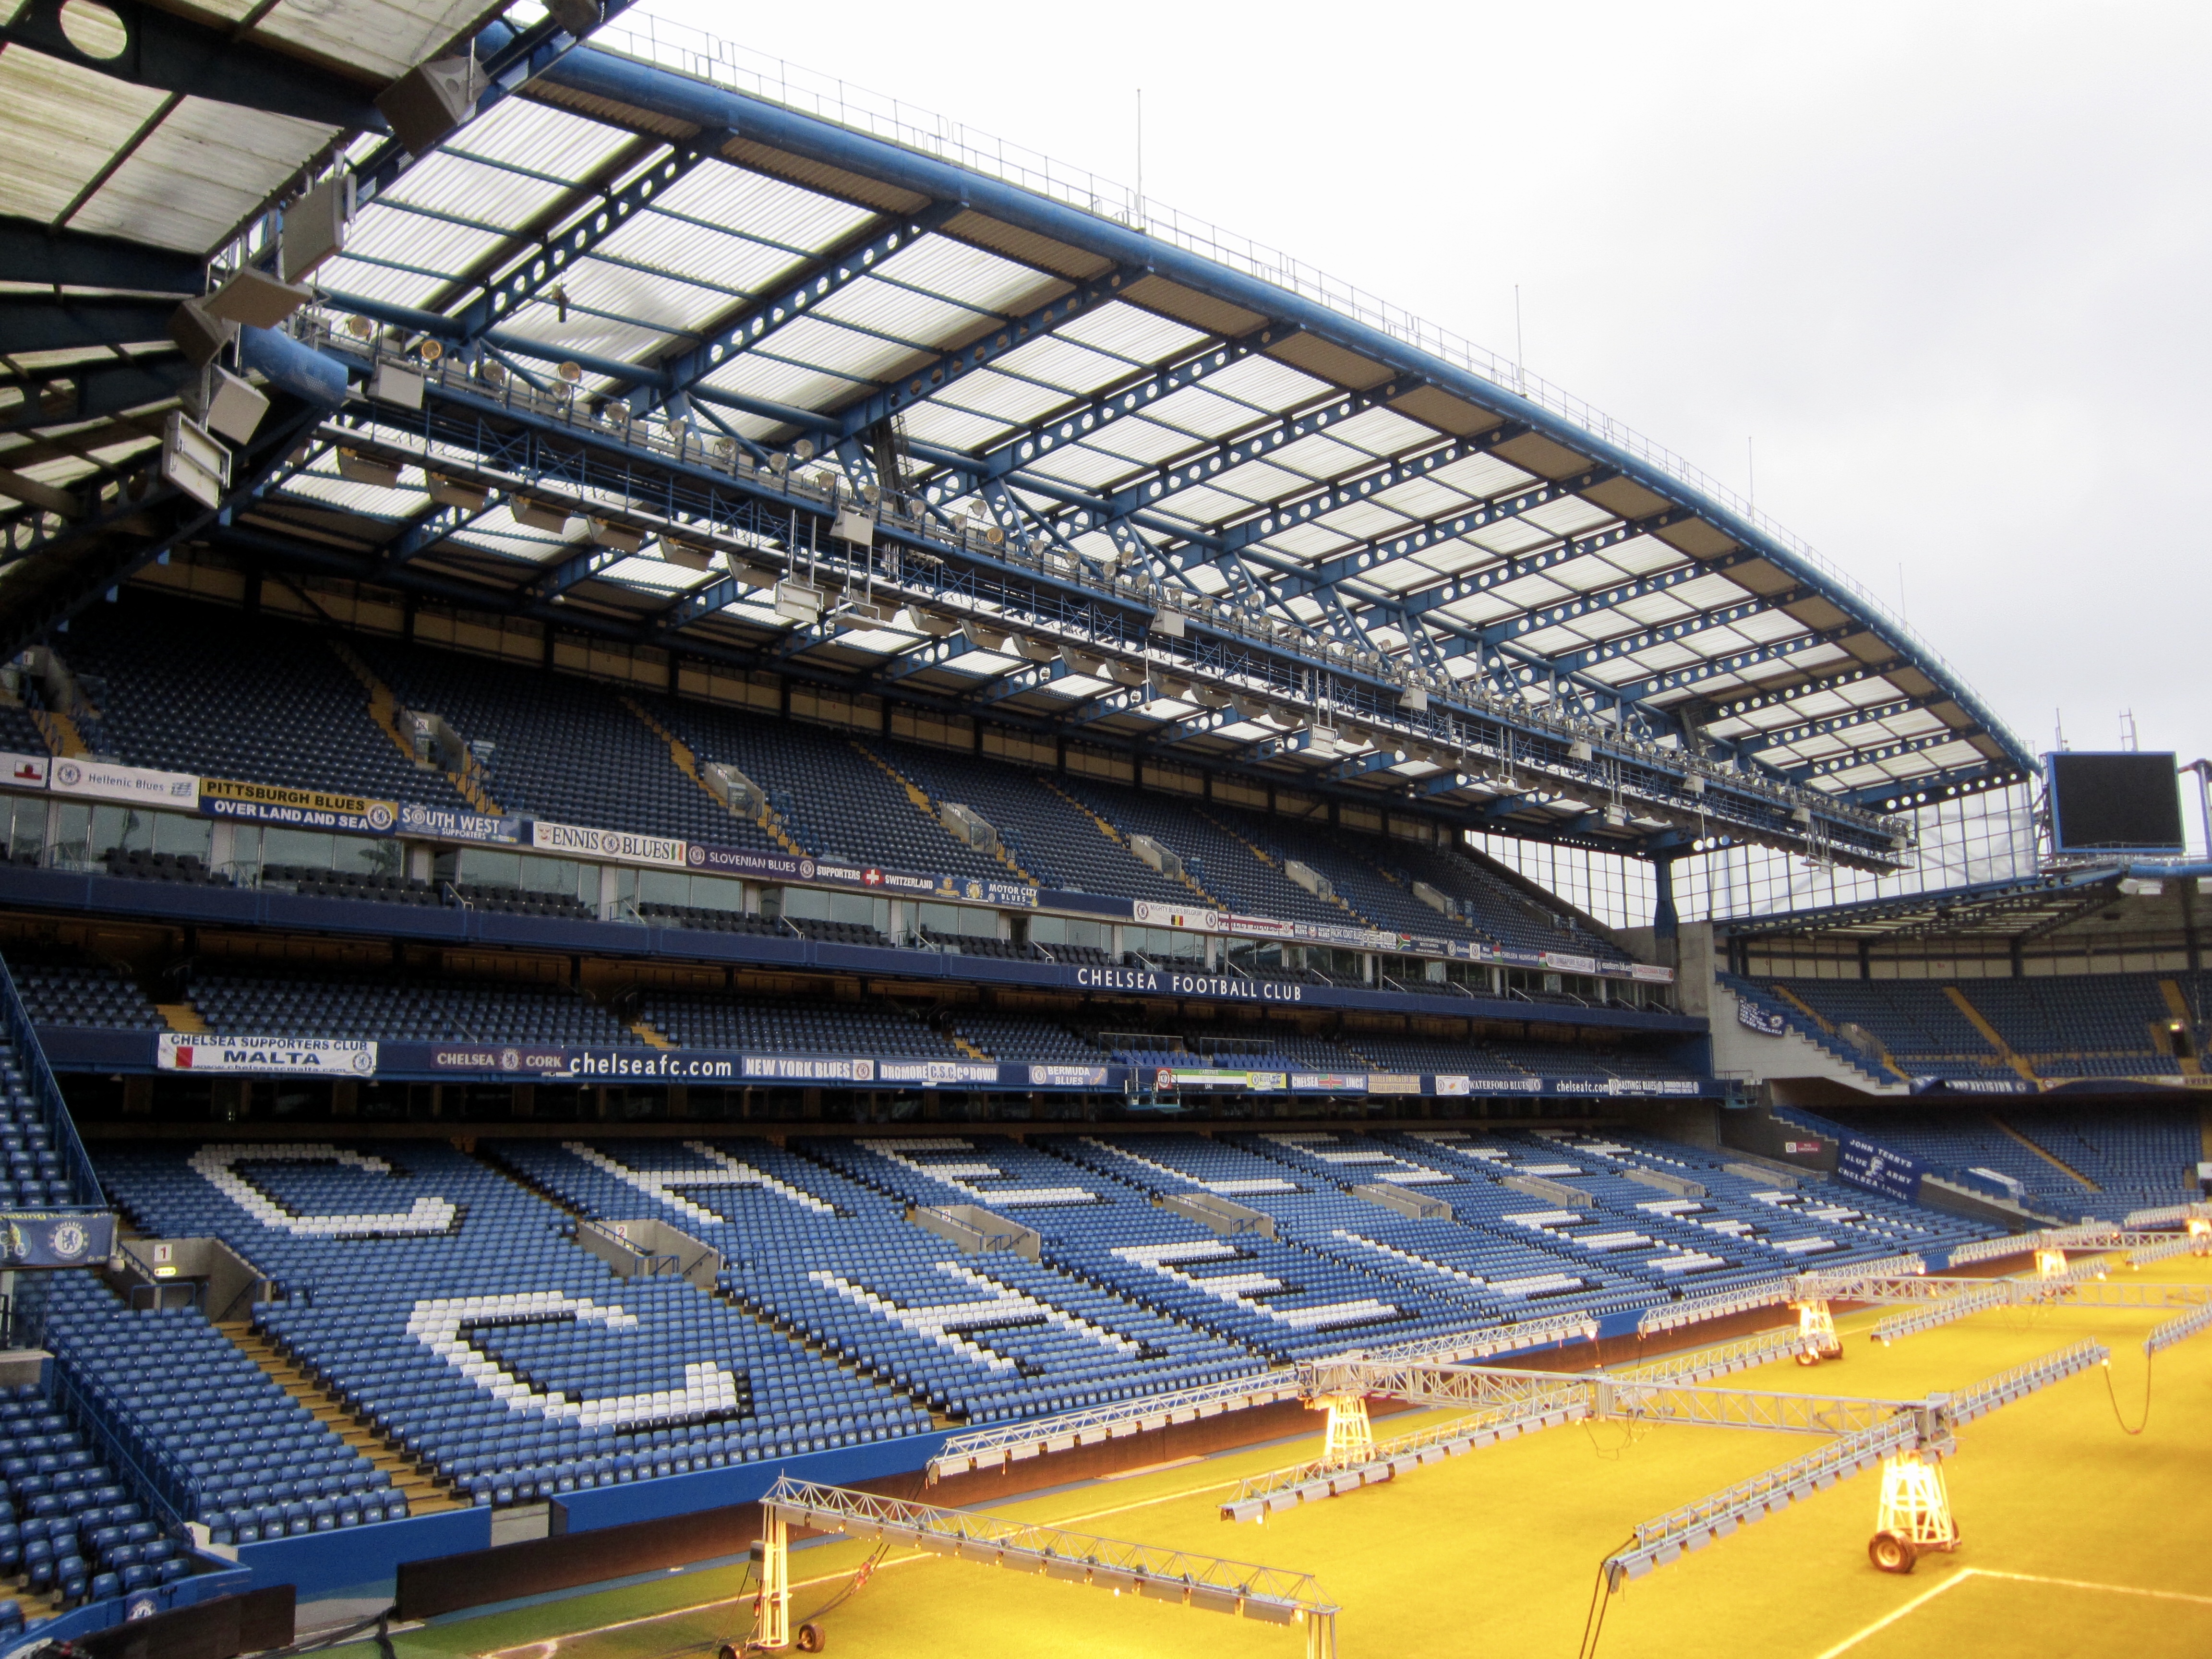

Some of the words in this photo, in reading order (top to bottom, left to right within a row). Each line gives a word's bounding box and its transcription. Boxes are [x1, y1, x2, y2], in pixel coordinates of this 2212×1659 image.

[88, 772, 132, 789] Hellenic
[136, 780, 164, 792] Blues
[207, 781, 310, 804] PITTSBURGH
[315, 795, 365, 811] BLUES
[215, 800, 256, 816] OVER
[260, 806, 302, 822] LAND
[303, 812, 336, 825] AND
[339, 816, 369, 830] SEA
[460, 815, 500, 834] WEST
[441, 827, 486, 840] SUPPORTERS
[552, 827, 599, 850] ENNIS
[622, 837, 670, 859] BLUES
[709, 852, 766, 868] SLOVENIAN
[769, 859, 796, 873] BLUES
[817, 866, 861, 880] SUPPORTERS
[885, 875, 934, 890] SWITZERLAND
[989, 883, 1019, 895] MOTOR
[1021, 888, 1038, 897] CITY
[1001, 894, 1026, 902] BLUES
[1150, 904, 1167, 913] MIGHTY
[1252, 923, 1279, 933] BLUES
[1343, 930, 1354, 939] COAST
[1519, 953, 1539, 962] HUNGARY
[1602, 962, 1619, 971] eastern
[1619, 962, 1632, 972] blues
[1077, 968, 1157, 990] CHELSEA
[1173, 975, 1258, 998] FOOTBALL
[1264, 984, 1301, 1001] CLUB
[171, 1034, 236, 1047] CHELSEA
[240, 1036, 329, 1050] SUPPORTERS
[334, 1040, 368, 1051] CLUB
[223, 1050, 321, 1065] MALTA
[437, 1053, 495, 1067] CHELSEA
[526, 1055, 563, 1069] CORK
[570, 1052, 732, 1076] chelseafc.com
[746, 1059, 777, 1075] NEW
[779, 1060, 813, 1078] YORK
[815, 1062, 851, 1079] BLUES
[880, 1063, 927, 1080] DROMORE
[930, 1065, 956, 1079] C.S.C.
[970, 1067, 998, 1081] DOWN
[1048, 1066, 1091, 1077] BERMUDA
[1055, 1075, 1084, 1086] BLUES
[1292, 1076, 1319, 1088] CHELSEA
[1346, 1077, 1364, 1088] LINCS
[1469, 1080, 1509, 1090] WATERFORD
[1510, 1081, 1529, 1090] BLUES
[1557, 1080, 1609, 1093] chelseafc.com
[1618, 1080, 1642, 1091] HASTINGS
[1643, 1080, 1657, 1091] BLUES
[1850, 1139, 1874, 1153] JOHN
[1845, 1153, 1868, 1167] BLUE
[1886, 1170, 1912, 1184] ARMY
[1838, 1166, 1878, 1187] CHELSEA
[1882, 1183, 1908, 1201] LOYAL
[618, 1226, 625, 1238] 2
[160, 1247, 167, 1259] 1
